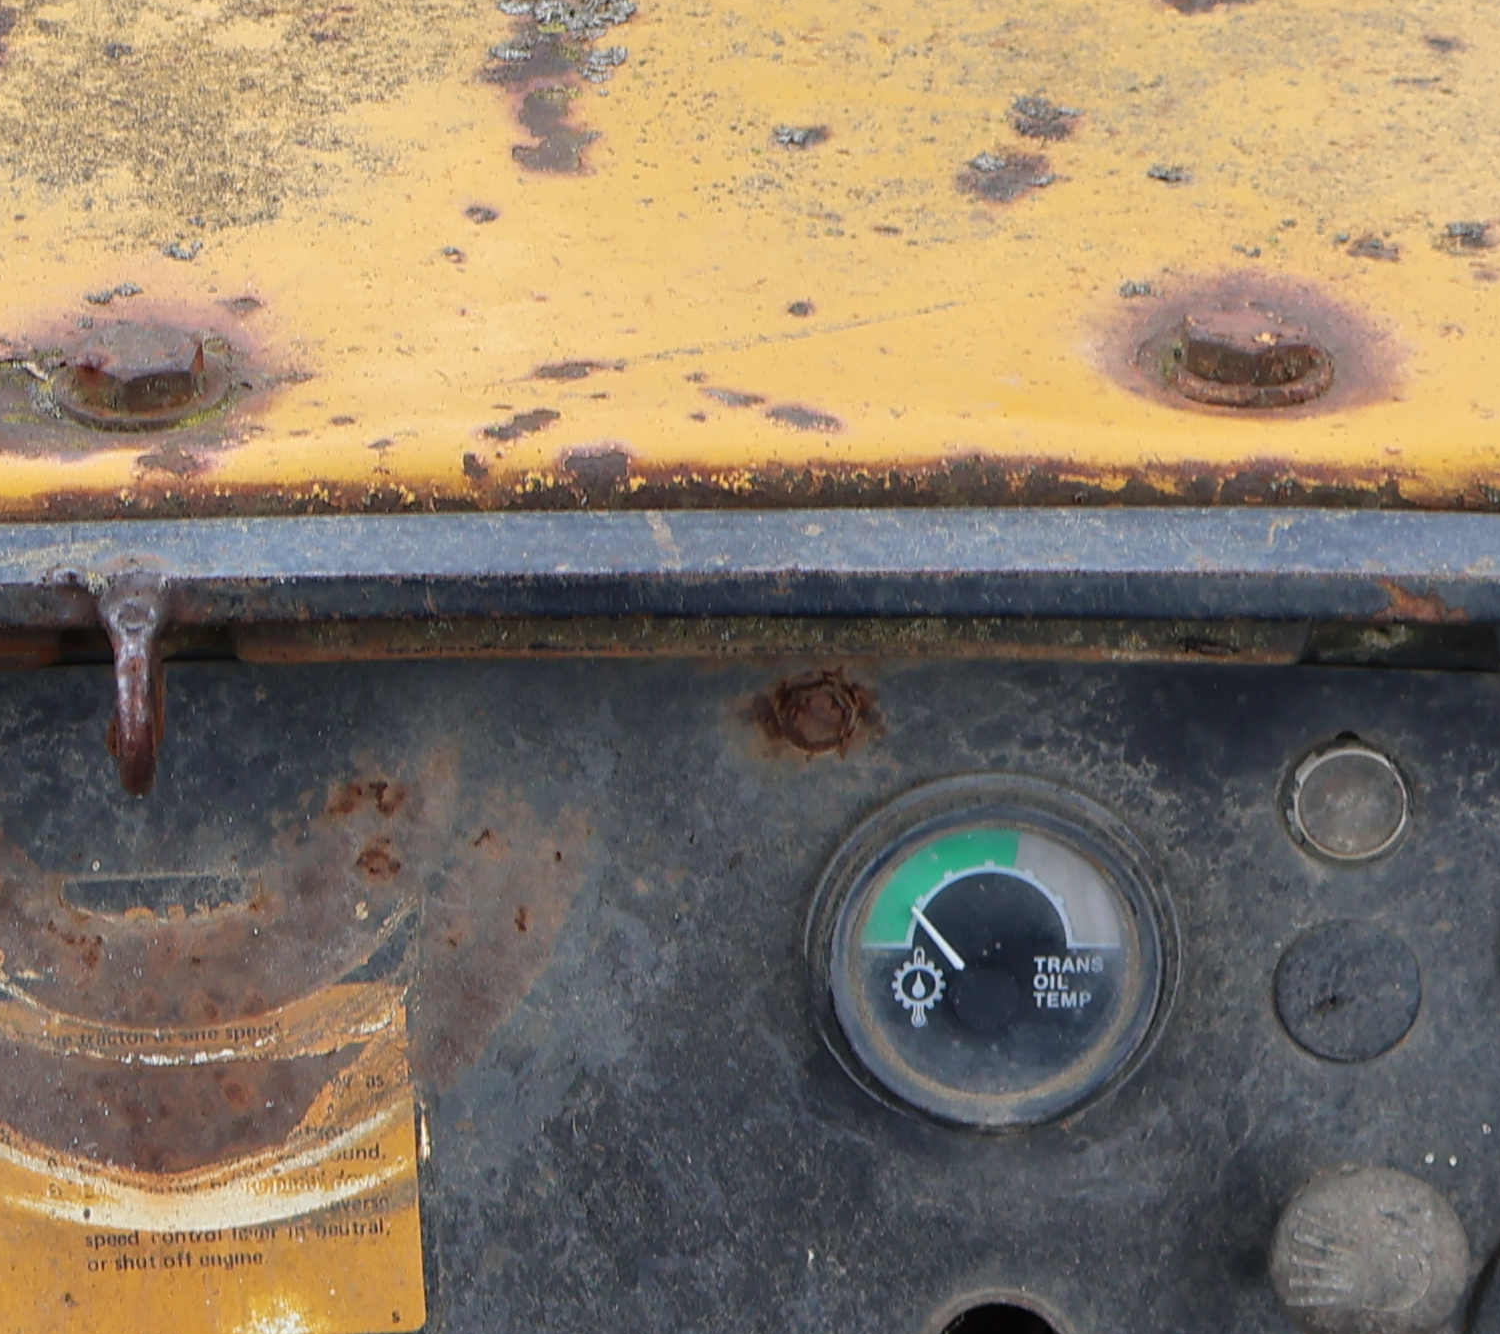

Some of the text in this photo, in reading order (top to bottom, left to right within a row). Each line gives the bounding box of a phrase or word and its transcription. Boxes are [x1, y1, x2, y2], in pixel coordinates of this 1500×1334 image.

[1033, 957, 1104, 974] TRANS
[1033, 974, 1069, 991] OIL
[1033, 991, 1092, 1009] TEMP
[85, 1231, 140, 1250] speed
[151, 1229, 222, 1244] control
[87, 1258, 107, 1272] or
[115, 1253, 156, 1270] shut
[164, 1252, 192, 1270] off
